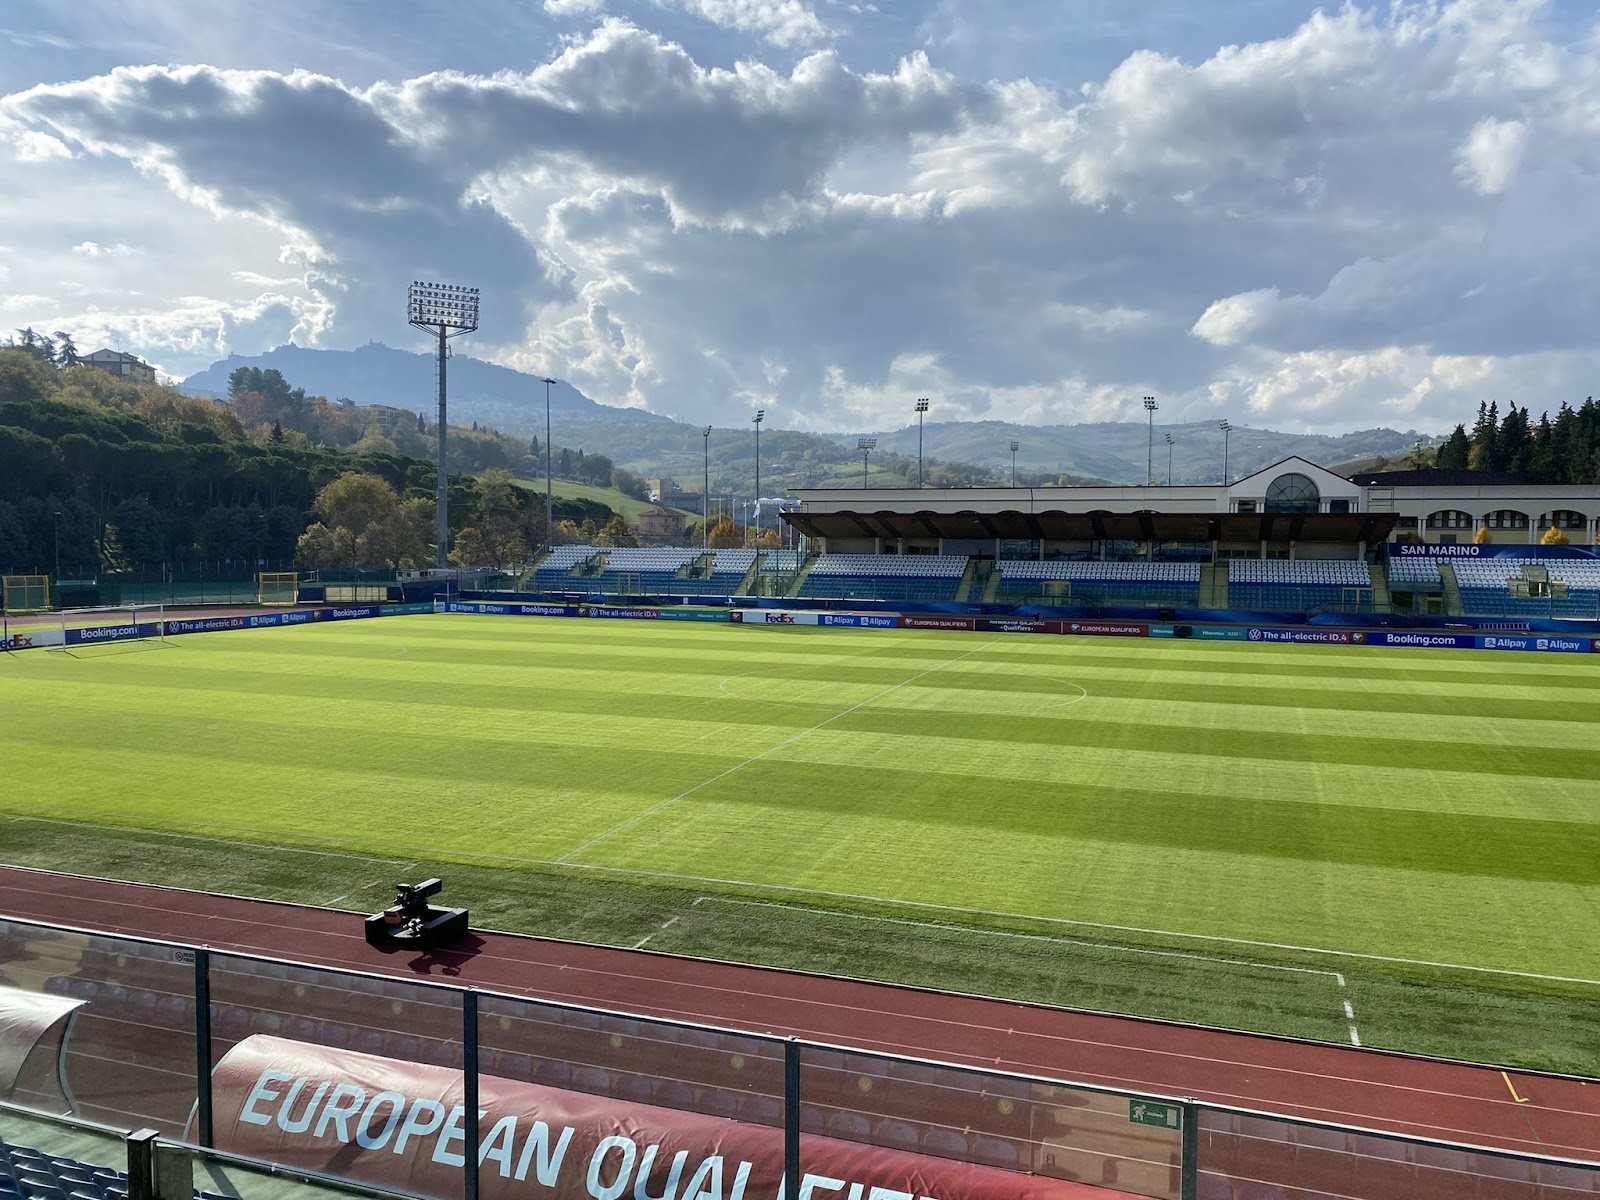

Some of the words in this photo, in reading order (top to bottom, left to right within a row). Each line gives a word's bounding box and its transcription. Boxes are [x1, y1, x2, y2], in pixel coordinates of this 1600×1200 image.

[1401, 545, 1426, 555] SAN
[1429, 545, 1480, 556] MARINO
[333, 607, 370, 618] Booking.com
[457, 604, 474, 613] Alipay
[487, 604, 504, 613] Alipay
[521, 605, 564, 615] Booking.com
[599, 609, 610, 617] The
[611, 609, 643, 617] all-electric
[644, 610, 657, 618] ID.4
[258, 615, 277, 626] Alipay
[289, 612, 306, 623] Alipay
[765, 612, 795, 624] FedEx
[833, 616, 855, 626] Alipay
[869, 616, 891, 627] Alipay
[180, 621, 194, 630] The
[195, 619, 229, 630] all-electric
[230, 618, 244, 628] ID.4
[914, 619, 939, 627] EUROPEAN
[940, 620, 967, 628] QUALIFIERS
[80, 627, 138, 639] Booking.com
[1082, 625, 1110, 633] EUROPEAN
[1110, 626, 1140, 634] QUALIFIERS
[1262, 631, 1280, 640] The
[1280, 631, 1327, 641] all-electric
[1329, 632, 1347, 642] ID.4
[1387, 633, 1456, 646] Booking.com
[1497, 638, 1527, 649] Alipay
[1550, 639, 1580, 650] Alipay
[239, 1069, 575, 1188] EUROPEAN
